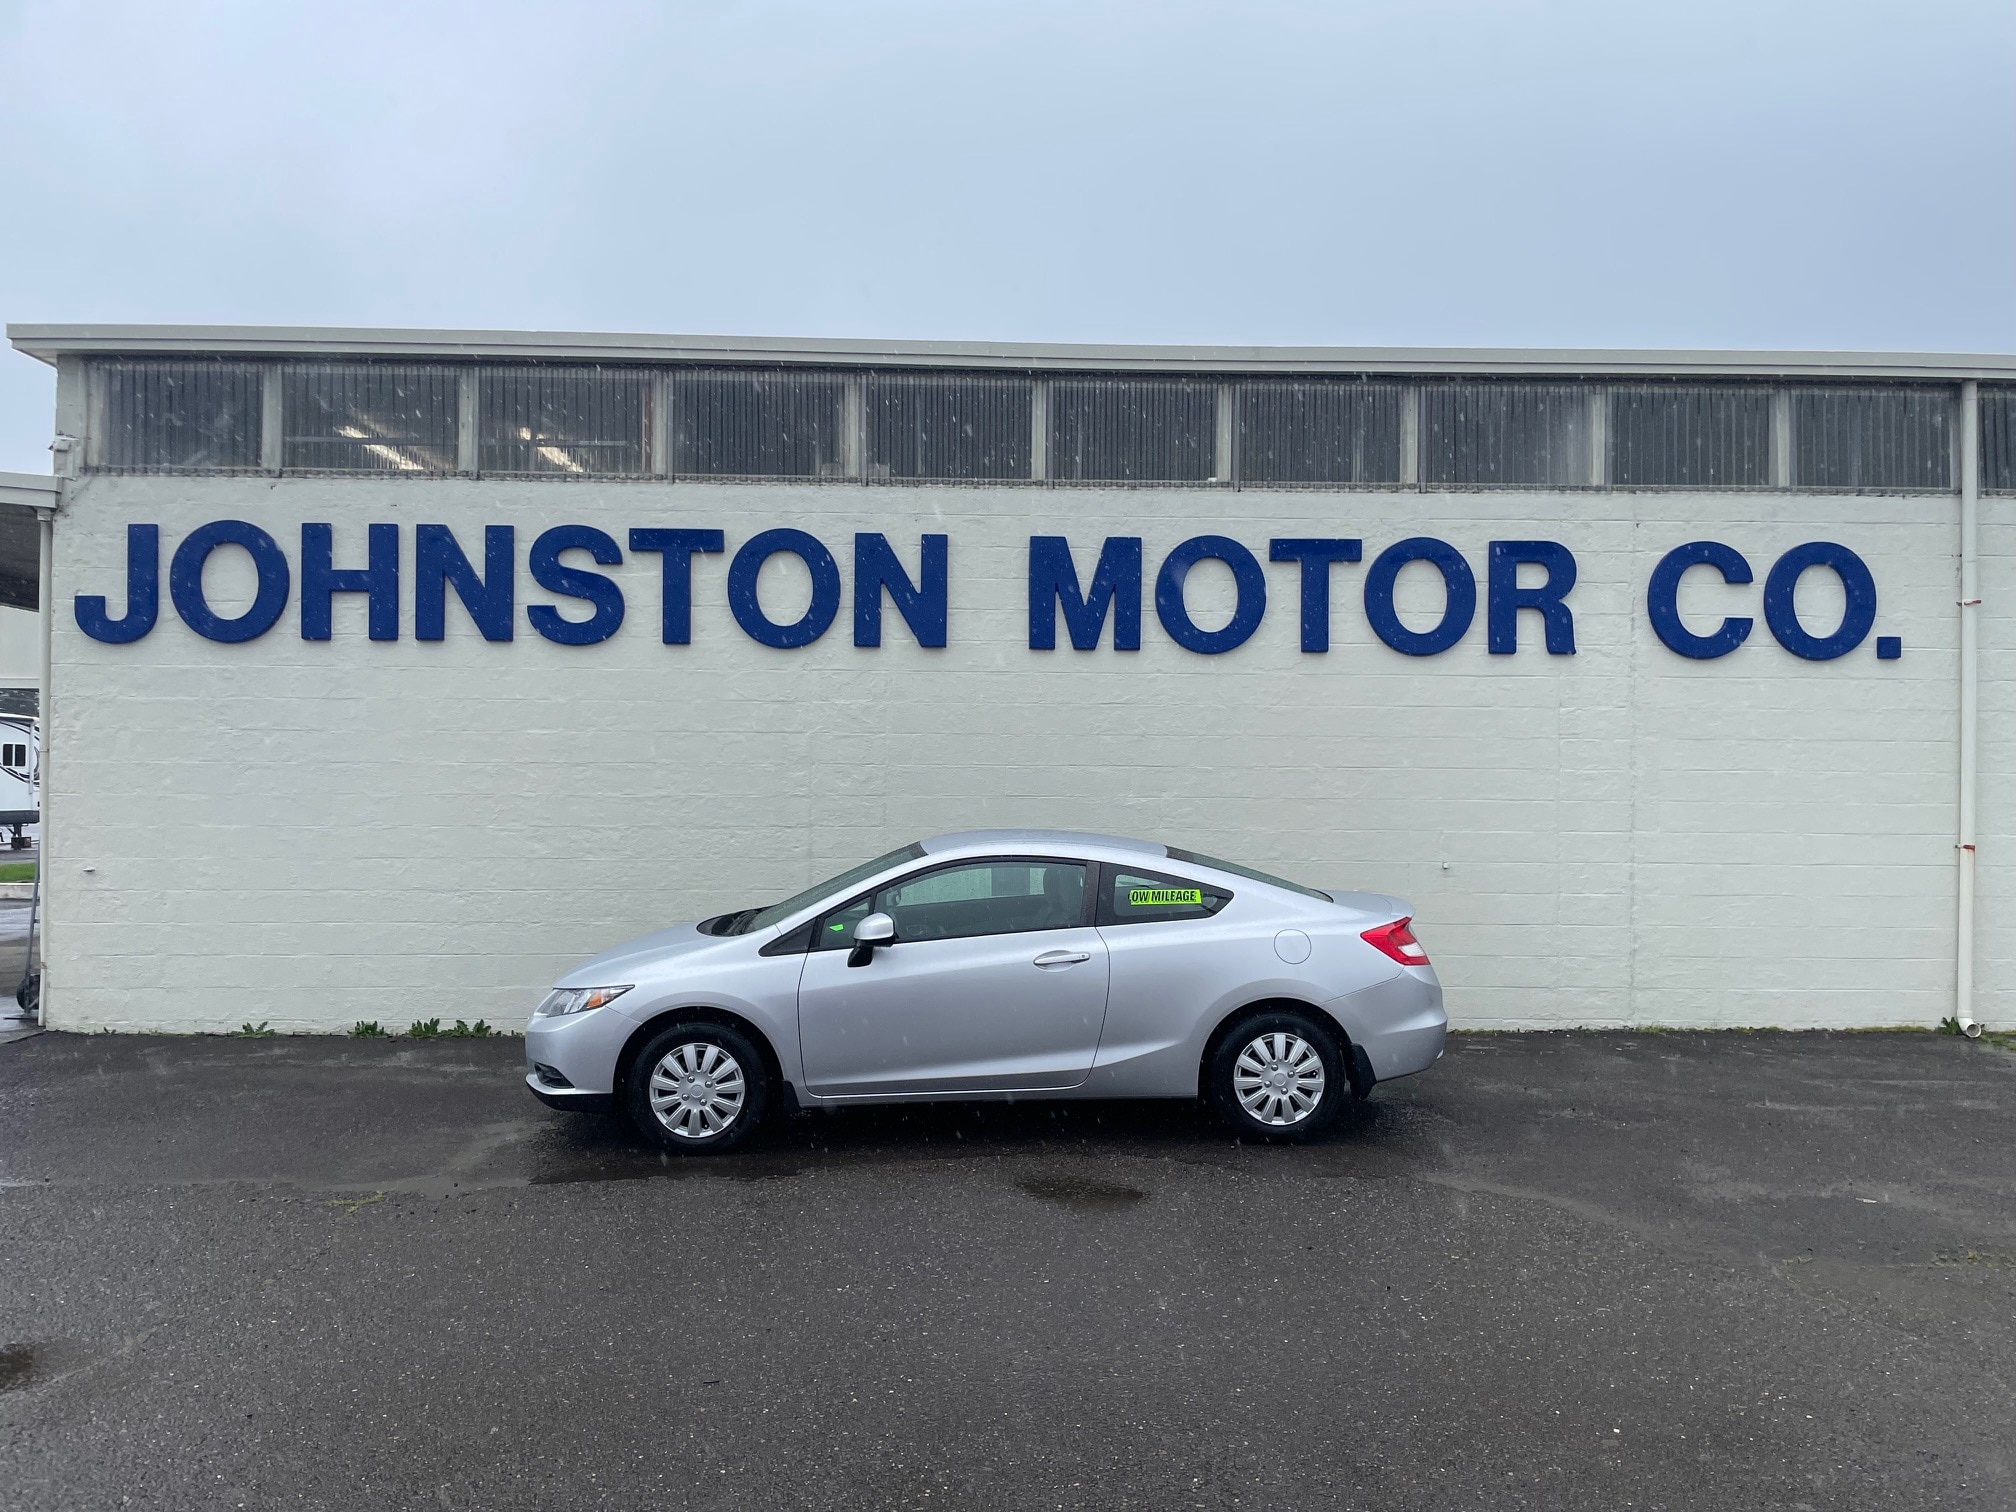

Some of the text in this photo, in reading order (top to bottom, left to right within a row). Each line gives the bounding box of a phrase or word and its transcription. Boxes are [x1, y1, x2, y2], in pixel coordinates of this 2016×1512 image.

[75, 520, 1902, 661] JOHNSTON MOTOR CO.
[1130, 890, 1196, 902] OW MILEAGE
